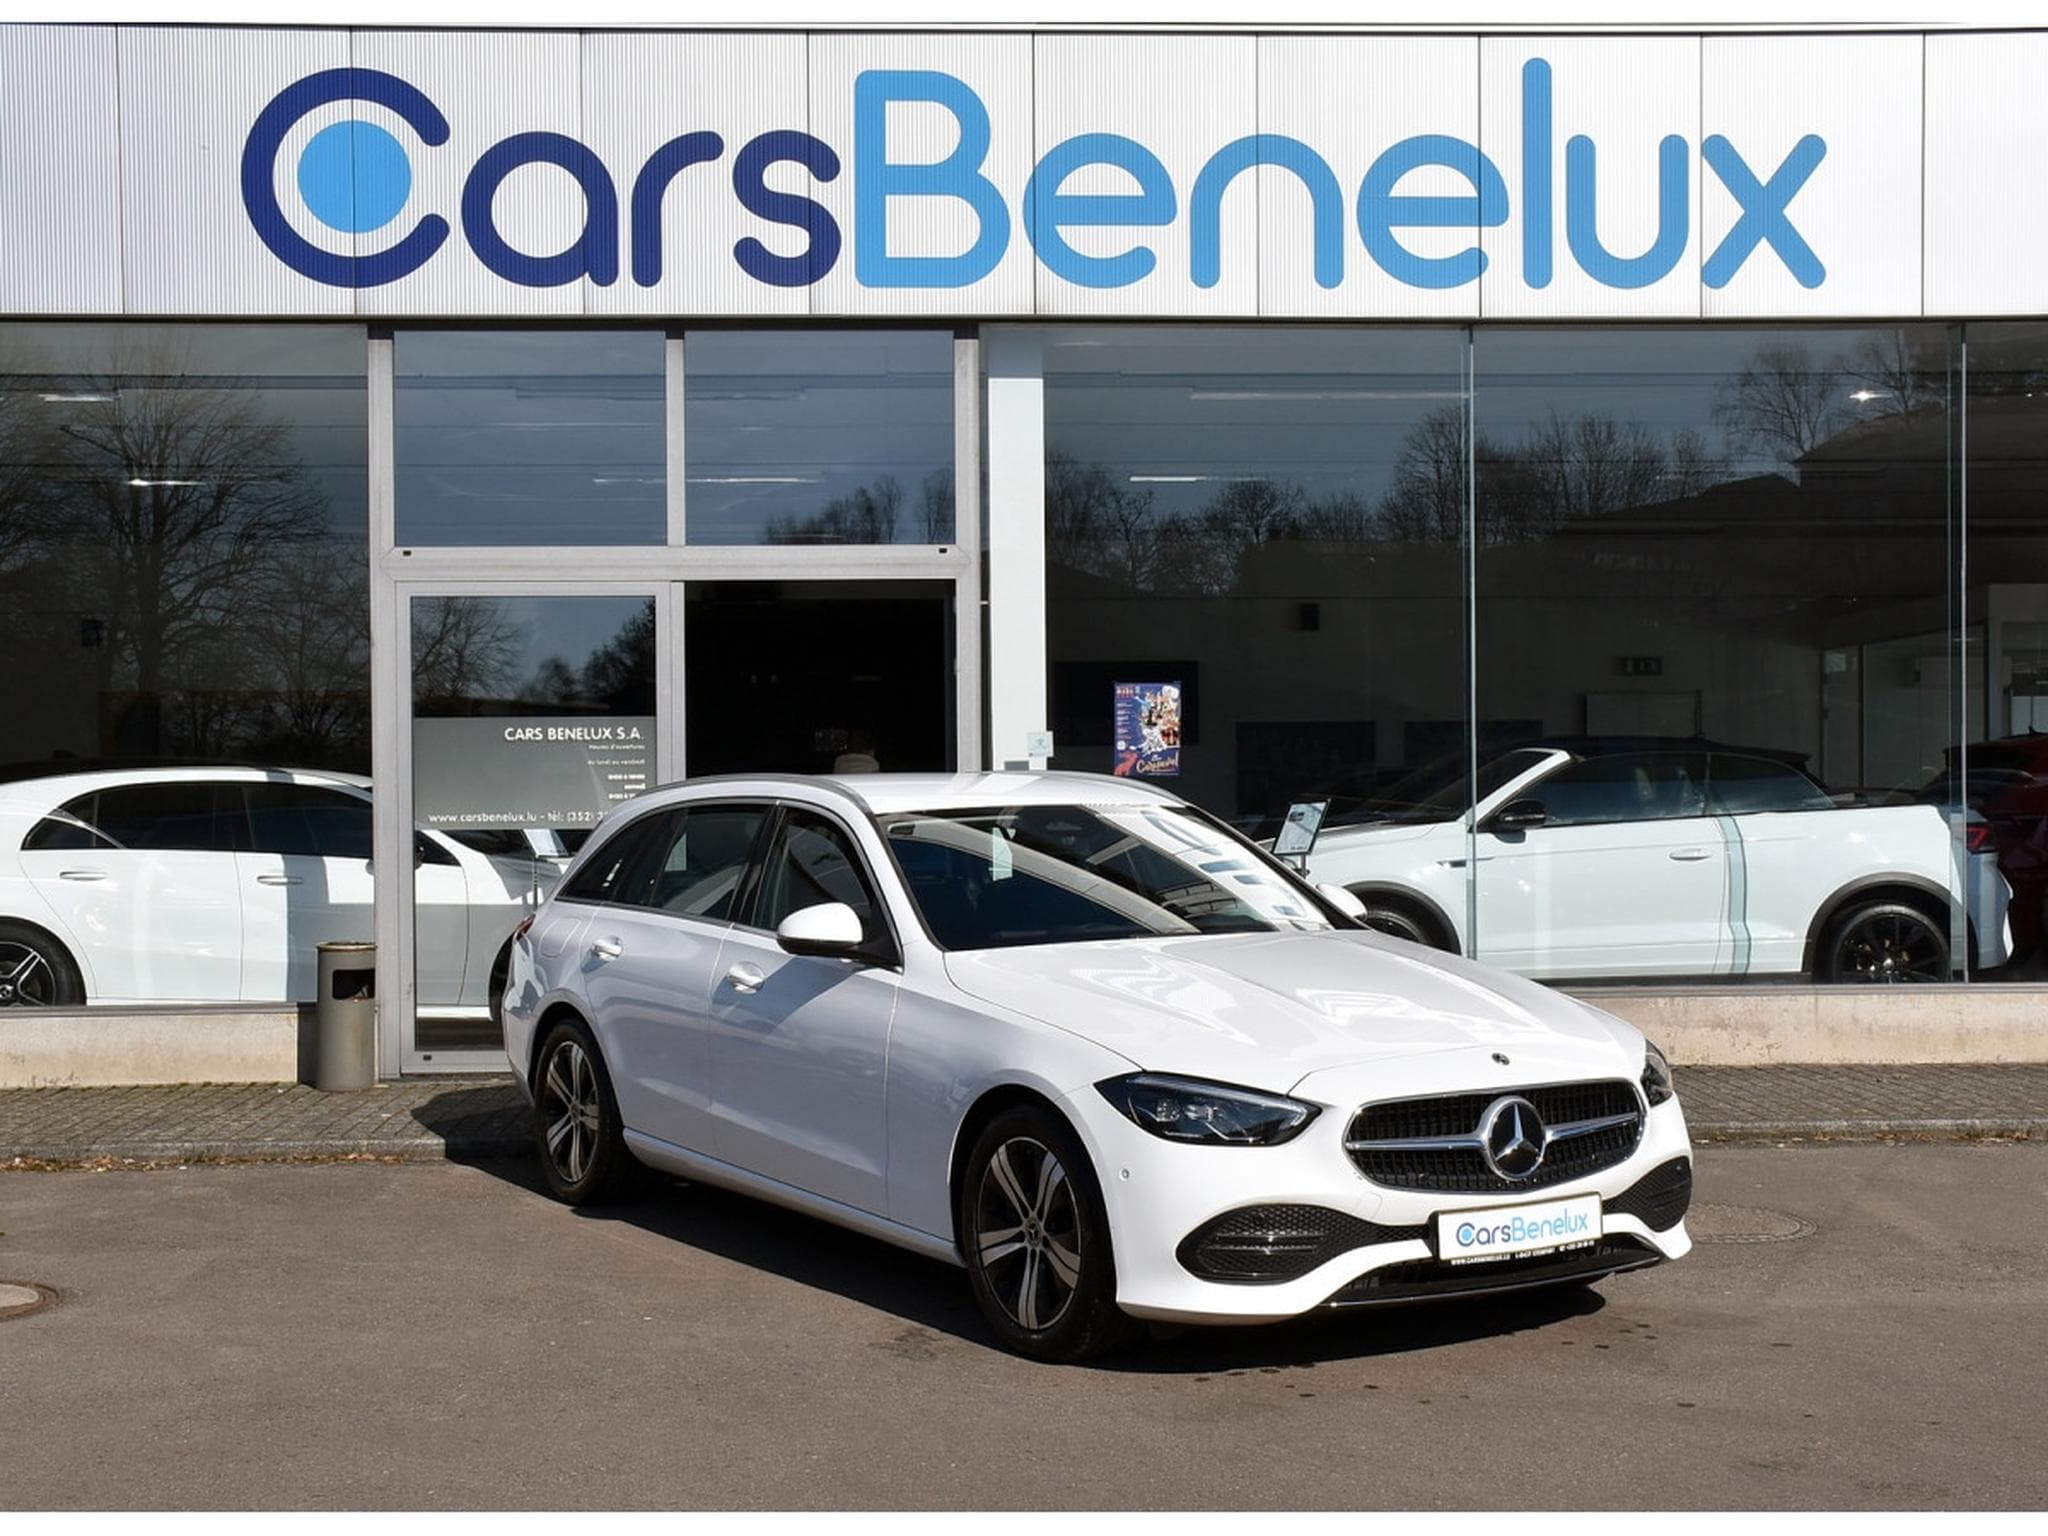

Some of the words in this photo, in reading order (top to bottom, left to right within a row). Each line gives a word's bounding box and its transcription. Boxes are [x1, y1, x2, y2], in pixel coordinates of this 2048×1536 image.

[241, 57, 1827, 289] CarsBenelux
[504, 727, 543, 742] CARS
[548, 726, 612, 741] BENELUX
[616, 726, 644, 741] S.A.
[428, 811, 537, 823] www.carsbenelux.lu
[1456, 1208, 1589, 1247] CarsBenelux
